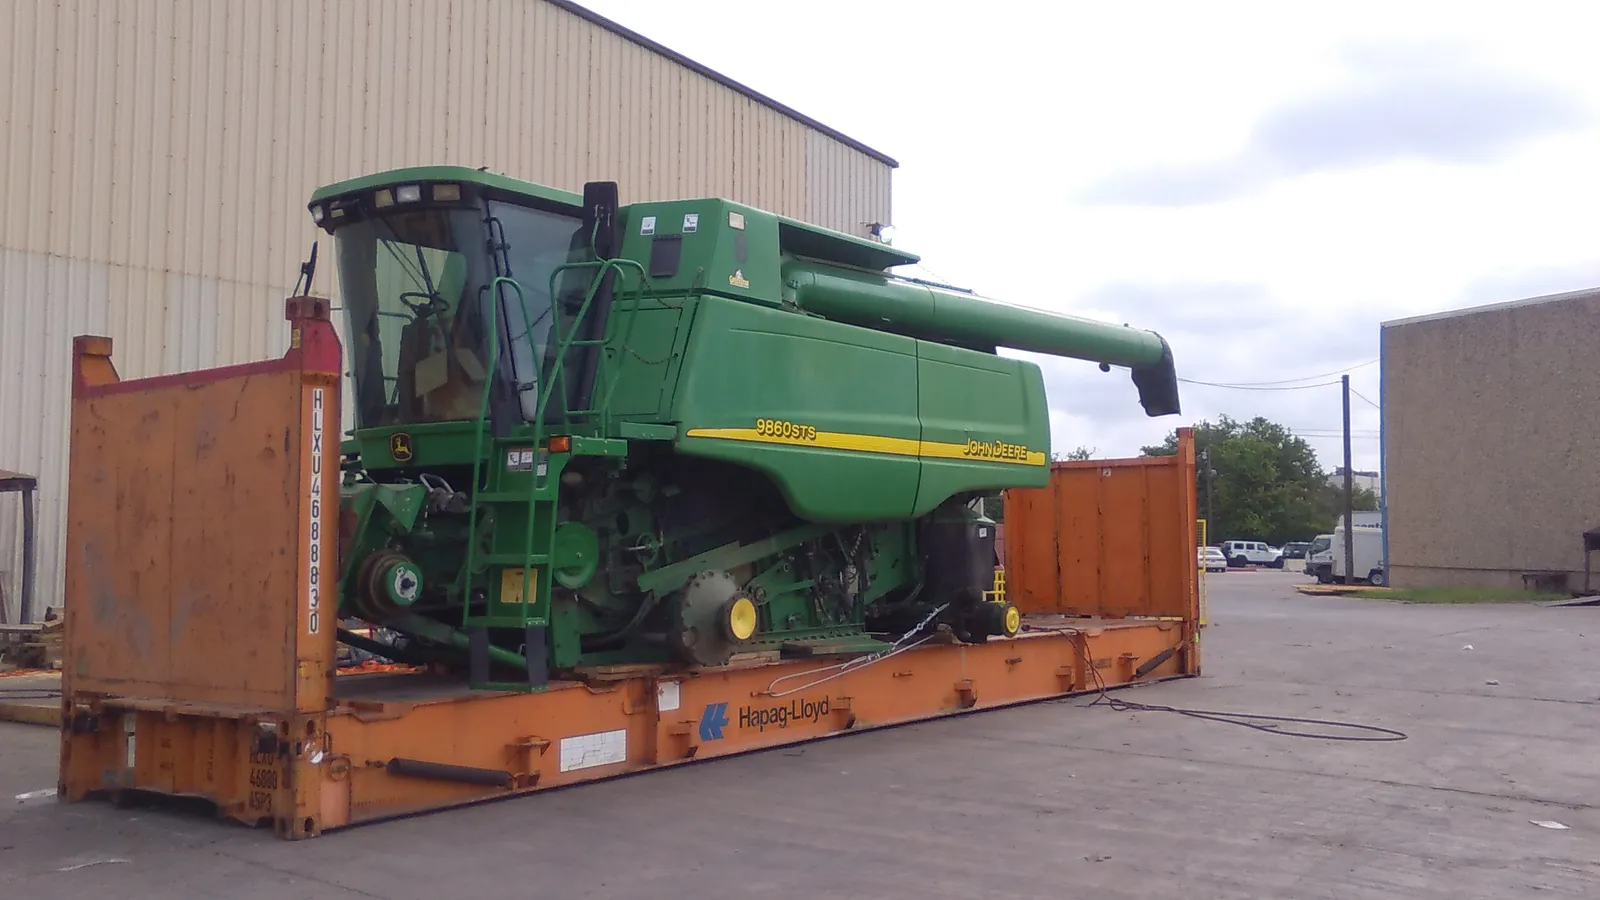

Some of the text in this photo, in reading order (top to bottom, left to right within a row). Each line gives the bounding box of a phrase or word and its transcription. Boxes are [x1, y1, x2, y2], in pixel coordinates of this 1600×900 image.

[756, 417, 817, 440] 9860STS
[963, 437, 1027, 460] JOHN DEERE
[738, 695, 830, 732] Hapag-Lloyd
